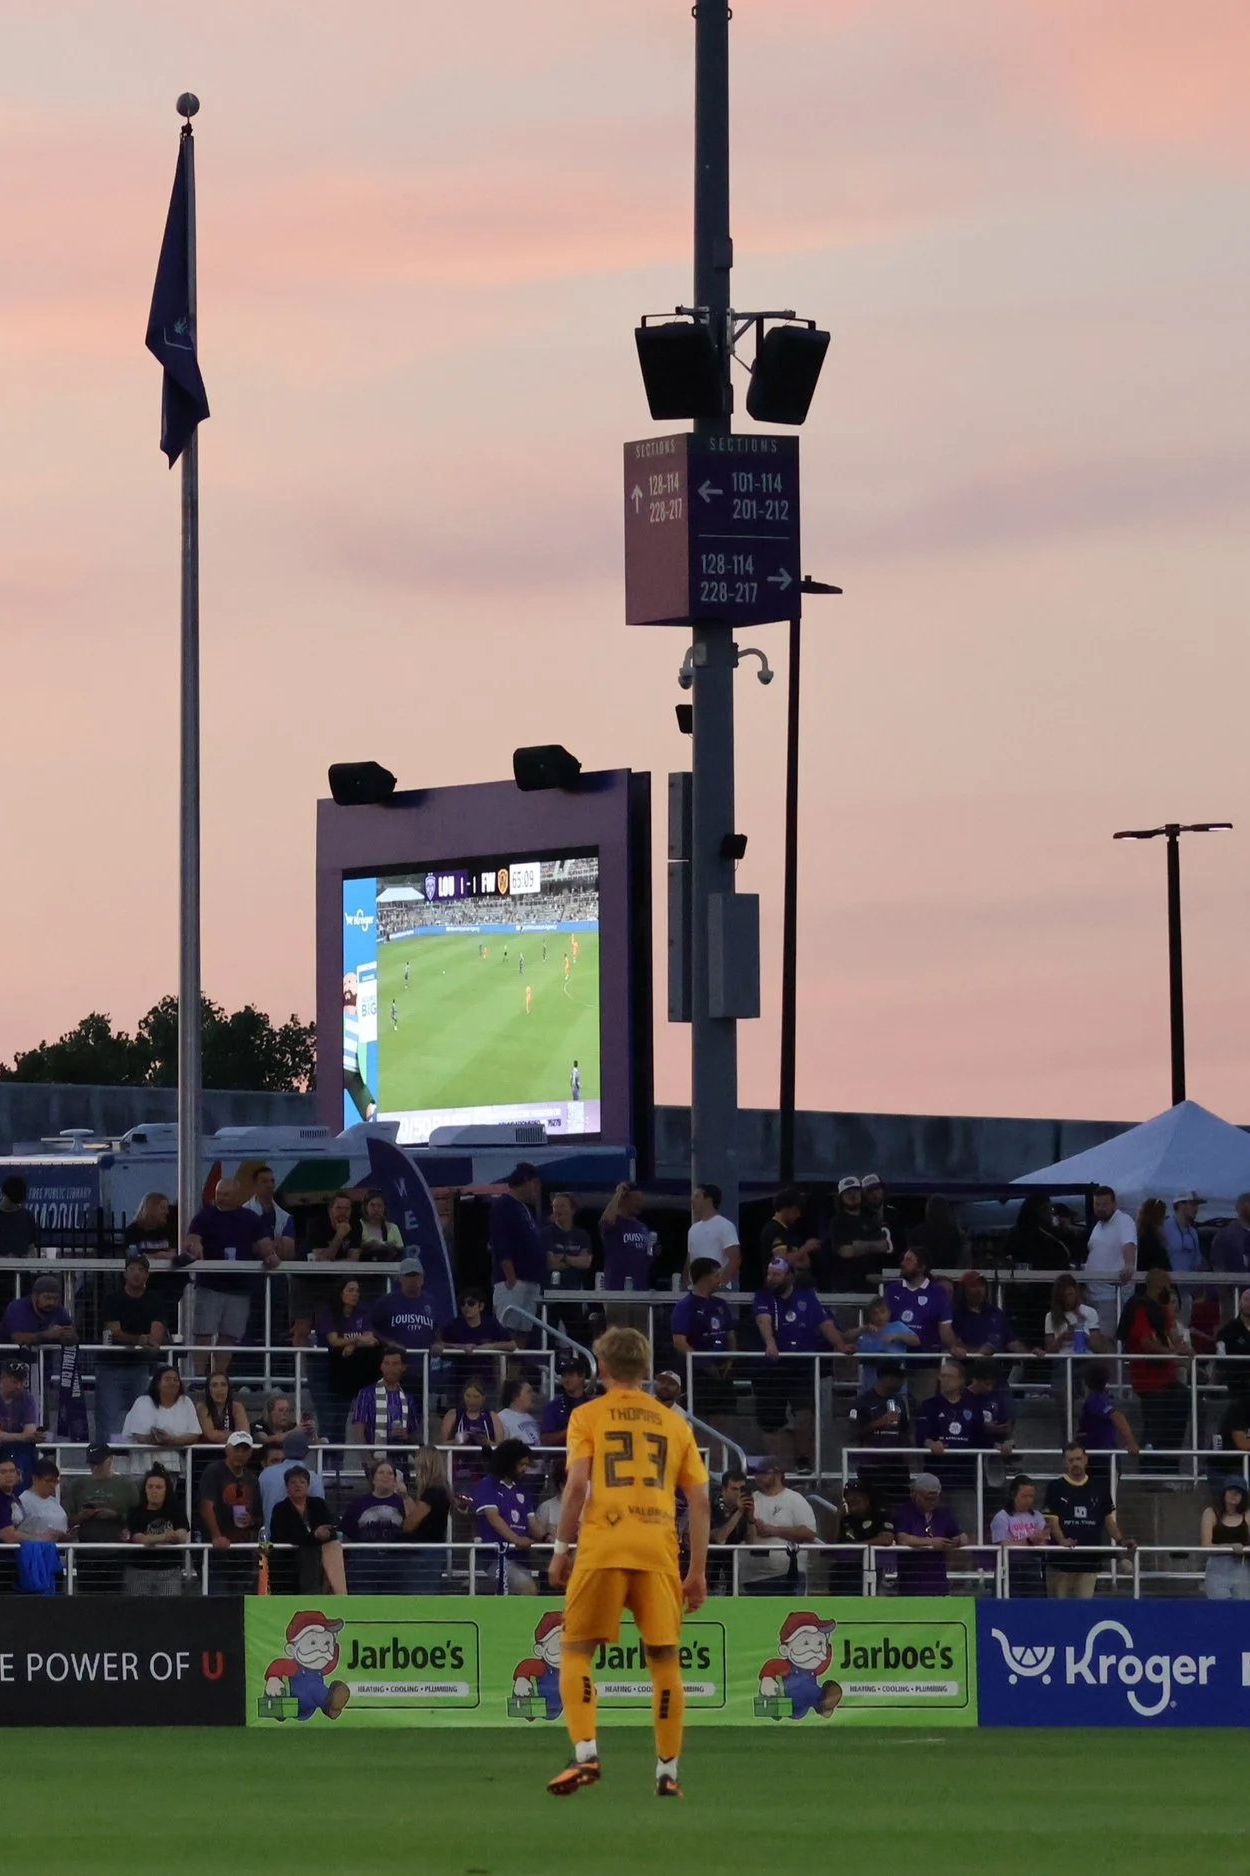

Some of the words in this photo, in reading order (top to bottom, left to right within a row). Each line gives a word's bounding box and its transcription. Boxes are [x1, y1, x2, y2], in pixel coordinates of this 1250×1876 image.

[636, 439, 676, 458] SECTIONS
[709, 436, 778, 453] SECTIONS
[649, 472, 680, 497] 128-114
[732, 472, 782, 494] 101-114
[649, 498, 683, 523] 228-217
[732, 499, 790, 521] 201-212
[701, 553, 755, 575] 128-114
[701, 581, 758, 604] 228-217
[439, 875, 454, 896] LOU
[609, 1407, 663, 1426] THOMAS
[604, 1430, 668, 1490] 23
[347, 1637, 464, 1670] Jarboe's
[595, 1637, 711, 1670] Jare's
[840, 1637, 954, 1670] Jarboe's
[26, 1653, 140, 1682] POWER
[149, 1653, 190, 1682] OF
[202, 1651, 224, 1681] U
[1065, 1620, 1217, 1717] Kroger
[357, 1685, 385, 1693] HEATING
[390, 1685, 419, 1693] COOLING
[424, 1685, 458, 1693] PLUMBING
[604, 1685, 632, 1693] HEATING
[849, 1685, 876, 1693] HEATING
[881, 1685, 910, 1693] COOLING
[915, 1685, 948, 1693] PLUMBING
